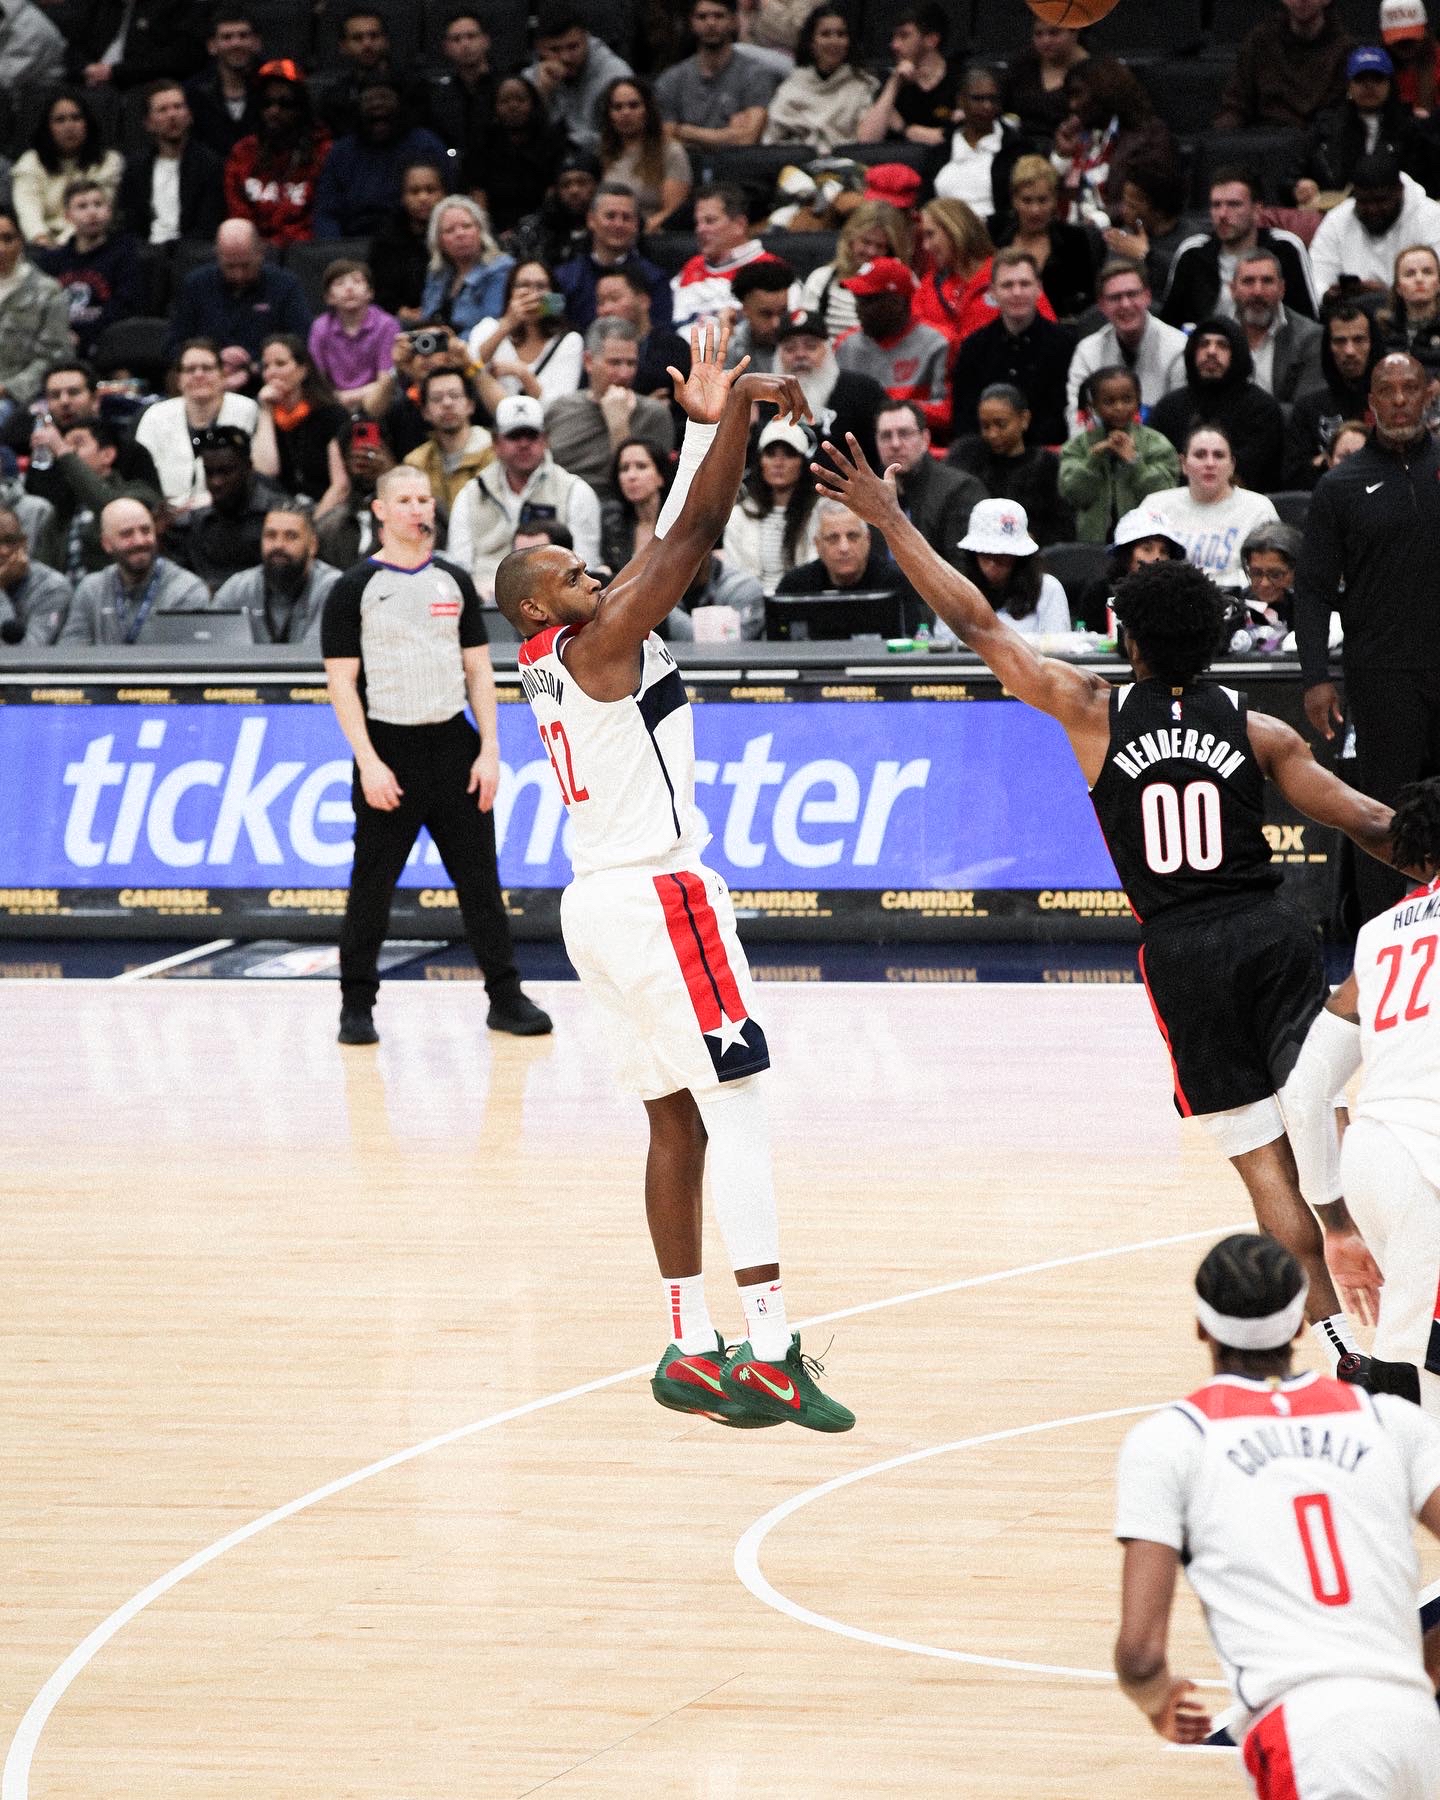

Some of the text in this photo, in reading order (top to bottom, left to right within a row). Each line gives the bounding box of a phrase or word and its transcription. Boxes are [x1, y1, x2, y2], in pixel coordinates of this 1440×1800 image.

[1112, 728, 1246, 779] HENDERSON
[1141, 780, 1223, 874] 00
[1374, 934, 1439, 1032] 22
[1227, 1425, 1371, 1476] COULIBALY
[1293, 1493, 1352, 1606] 0
